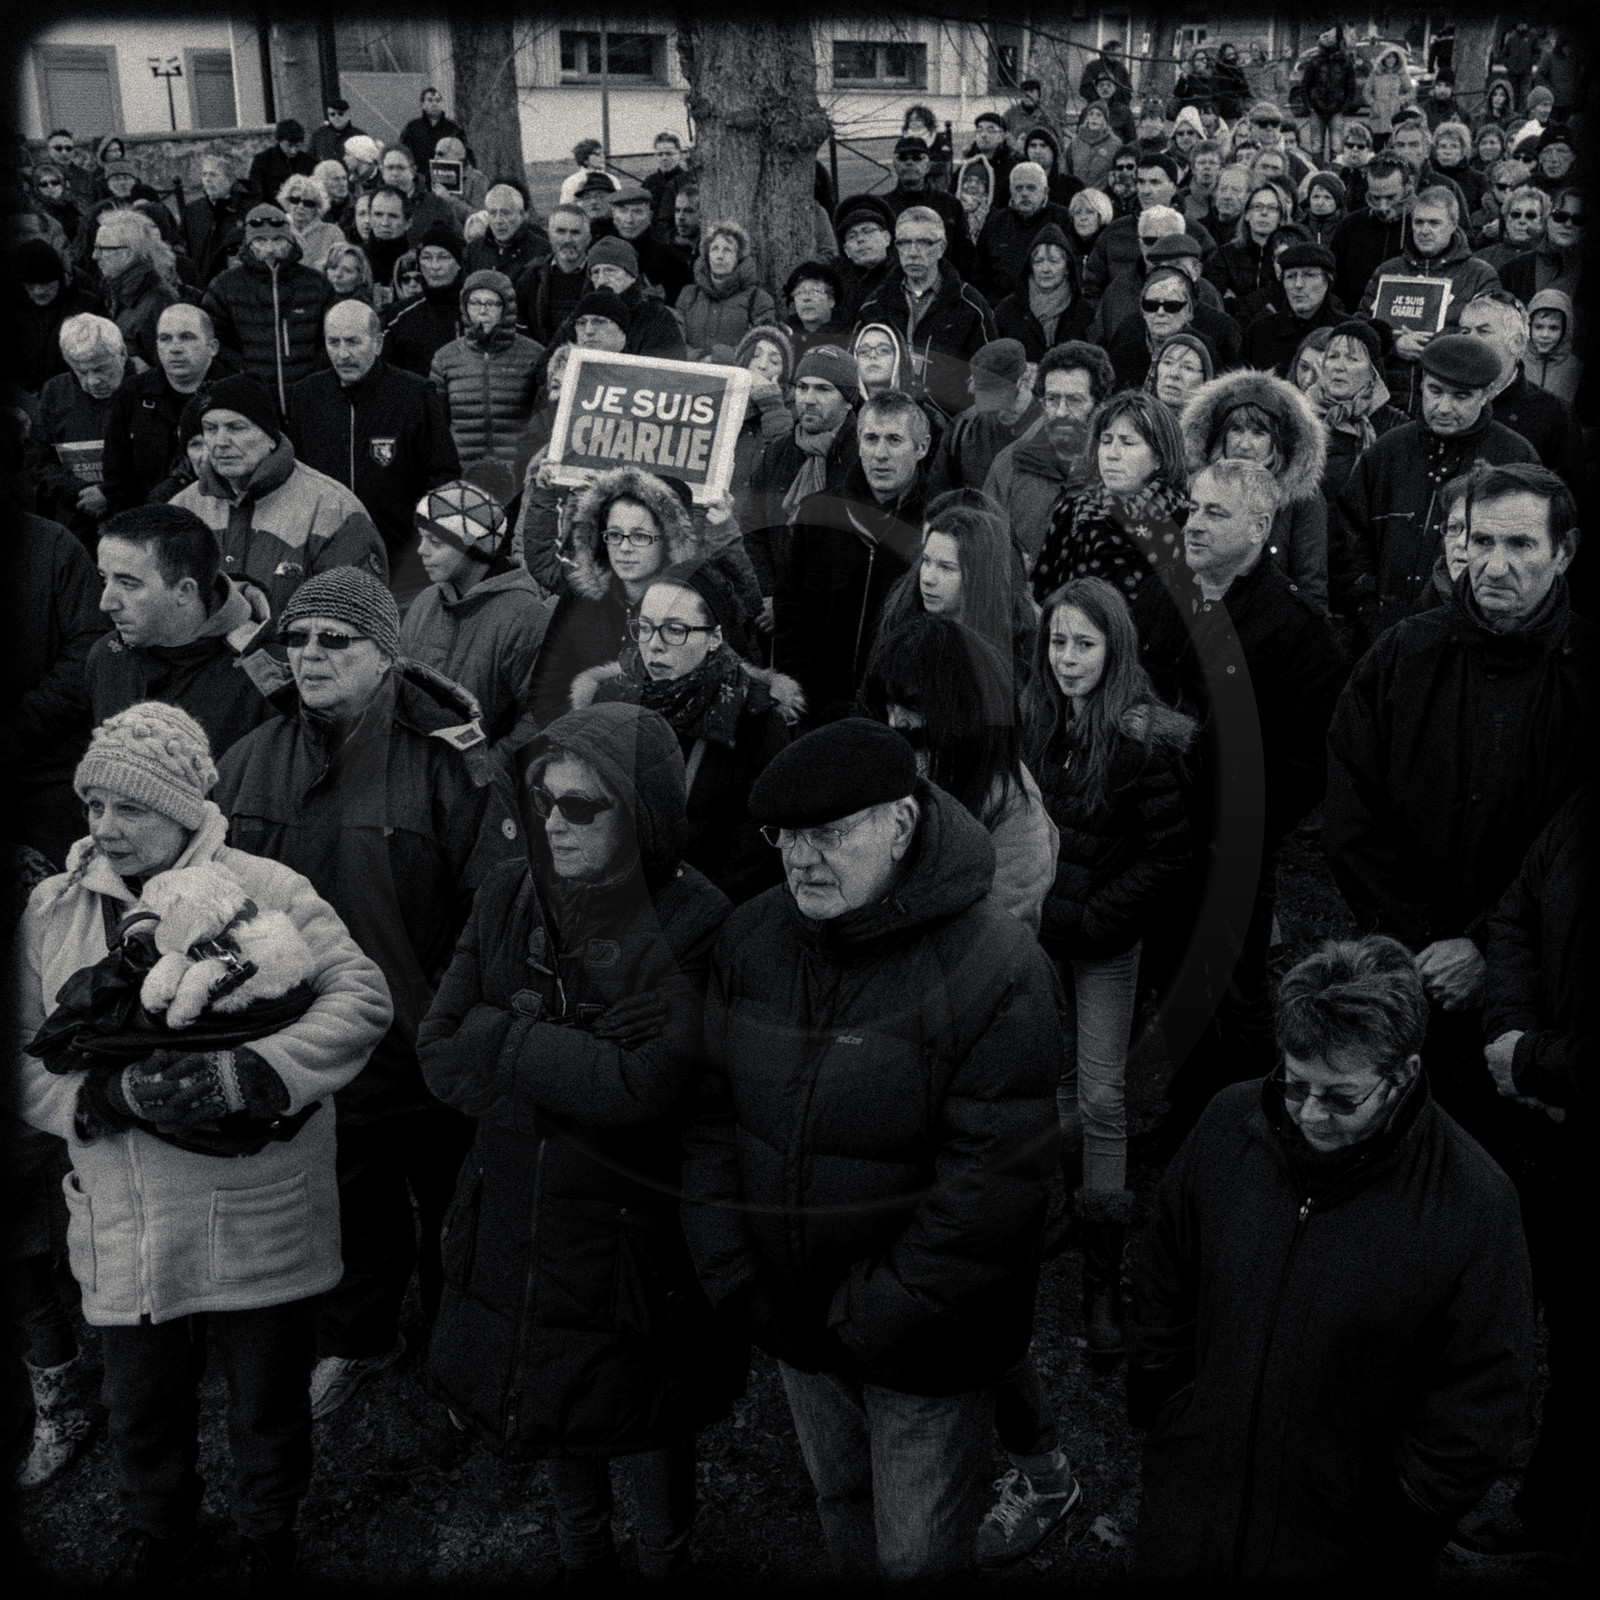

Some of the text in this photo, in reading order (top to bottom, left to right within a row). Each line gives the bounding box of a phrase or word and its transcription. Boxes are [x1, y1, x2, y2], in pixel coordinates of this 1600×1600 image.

[1391, 305, 1423, 318] CHARLIE
[1393, 295, 1425, 306] JE SUIS
[580, 384, 715, 425] JE SUIS
[571, 414, 713, 471] CHARLIE
